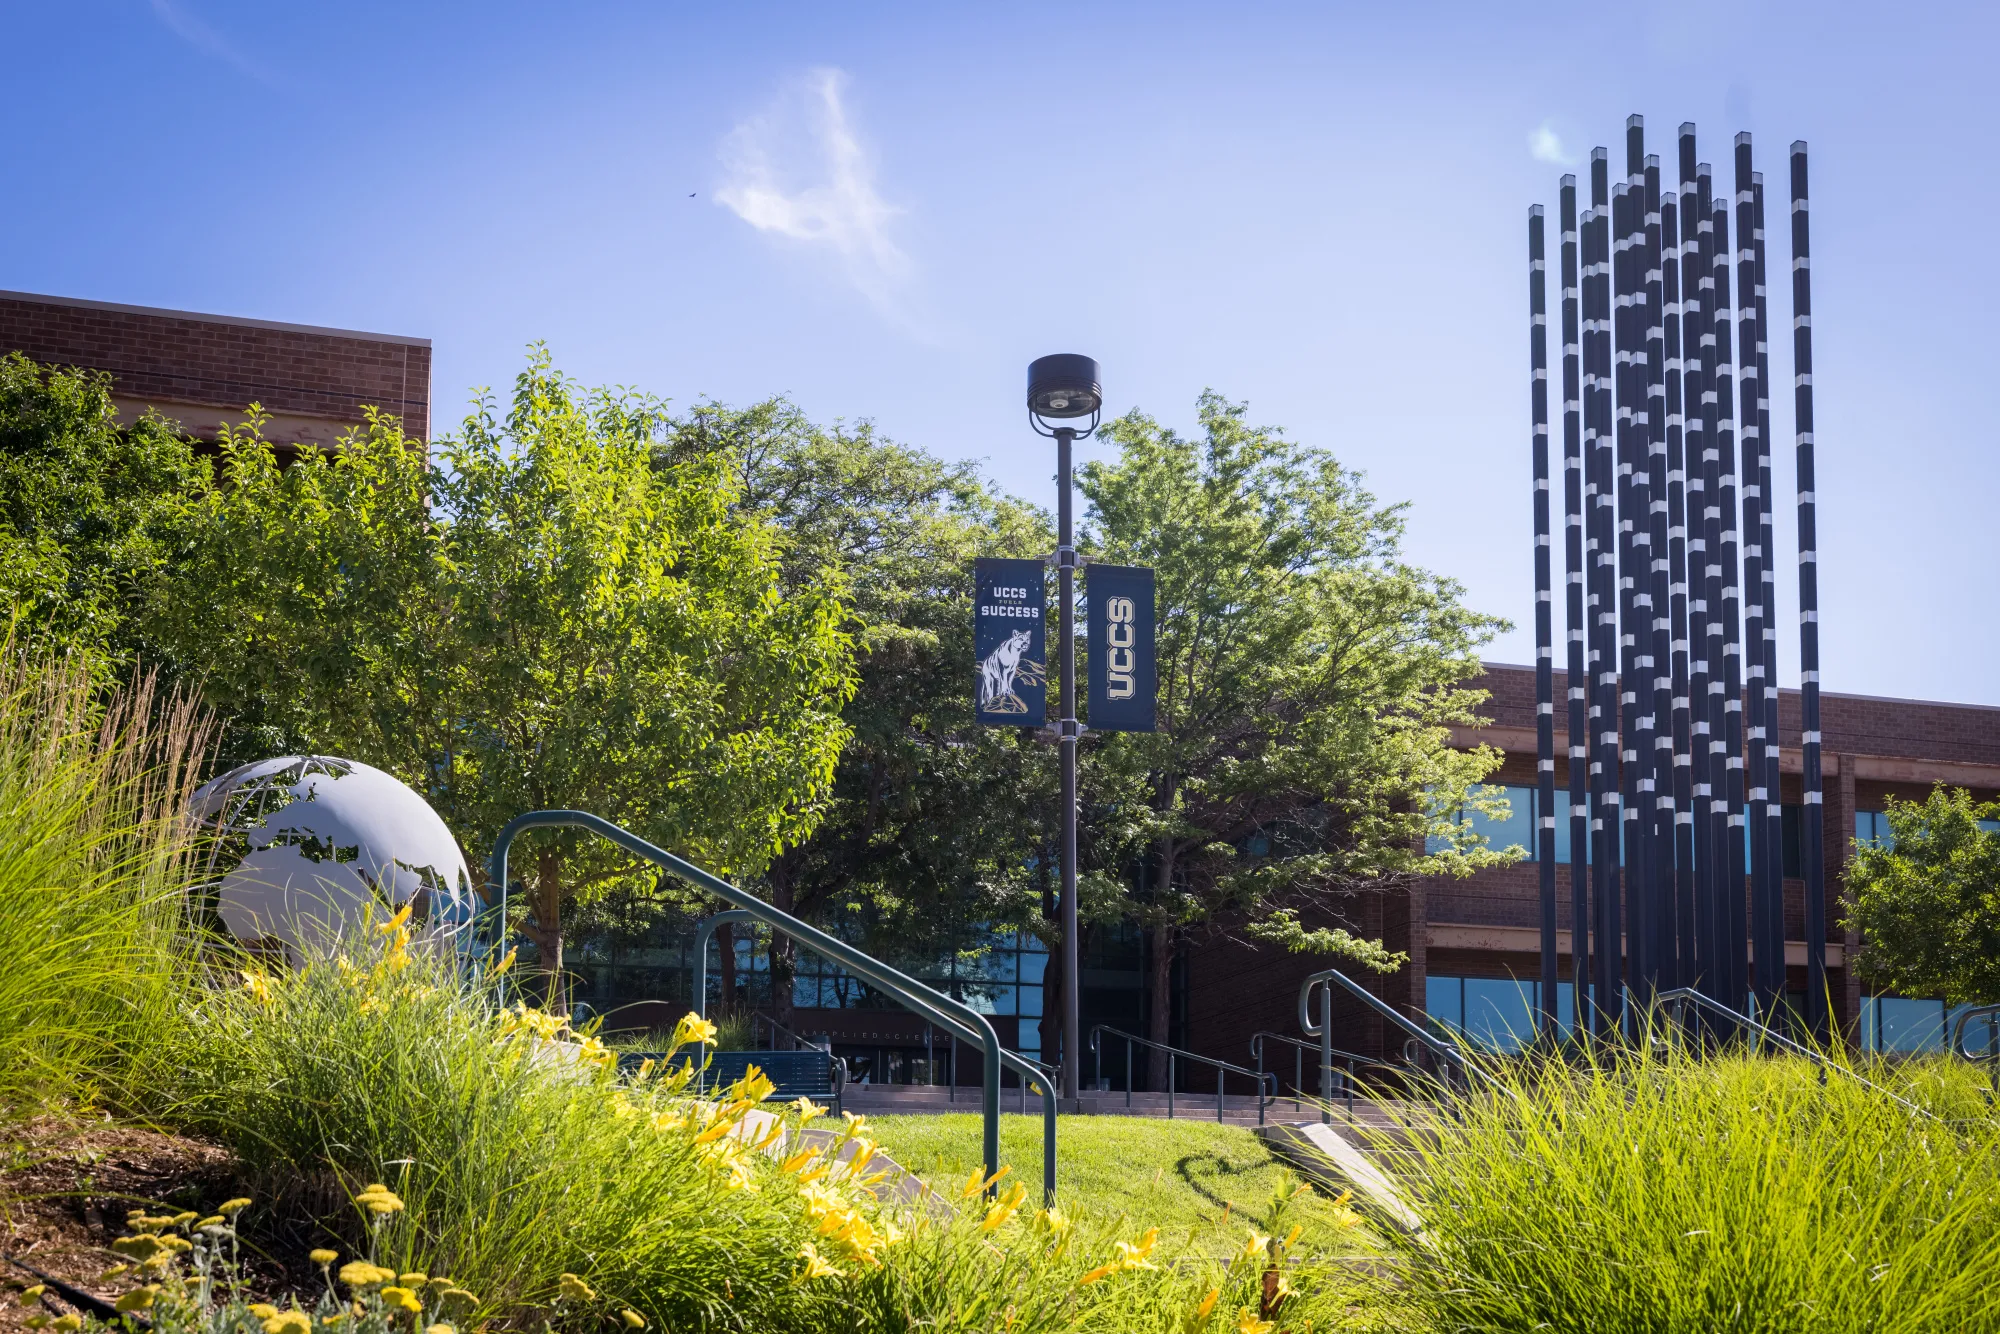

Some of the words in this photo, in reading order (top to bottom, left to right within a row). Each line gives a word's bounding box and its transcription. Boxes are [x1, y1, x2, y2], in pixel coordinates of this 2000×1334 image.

[993, 587, 1027, 599] UCCS
[981, 605, 1039, 618] SUCCESS
[1107, 596, 1135, 700] UCCS
[812, 1029, 878, 1039] APPLIED
[885, 1033, 949, 1042] SCIECE
